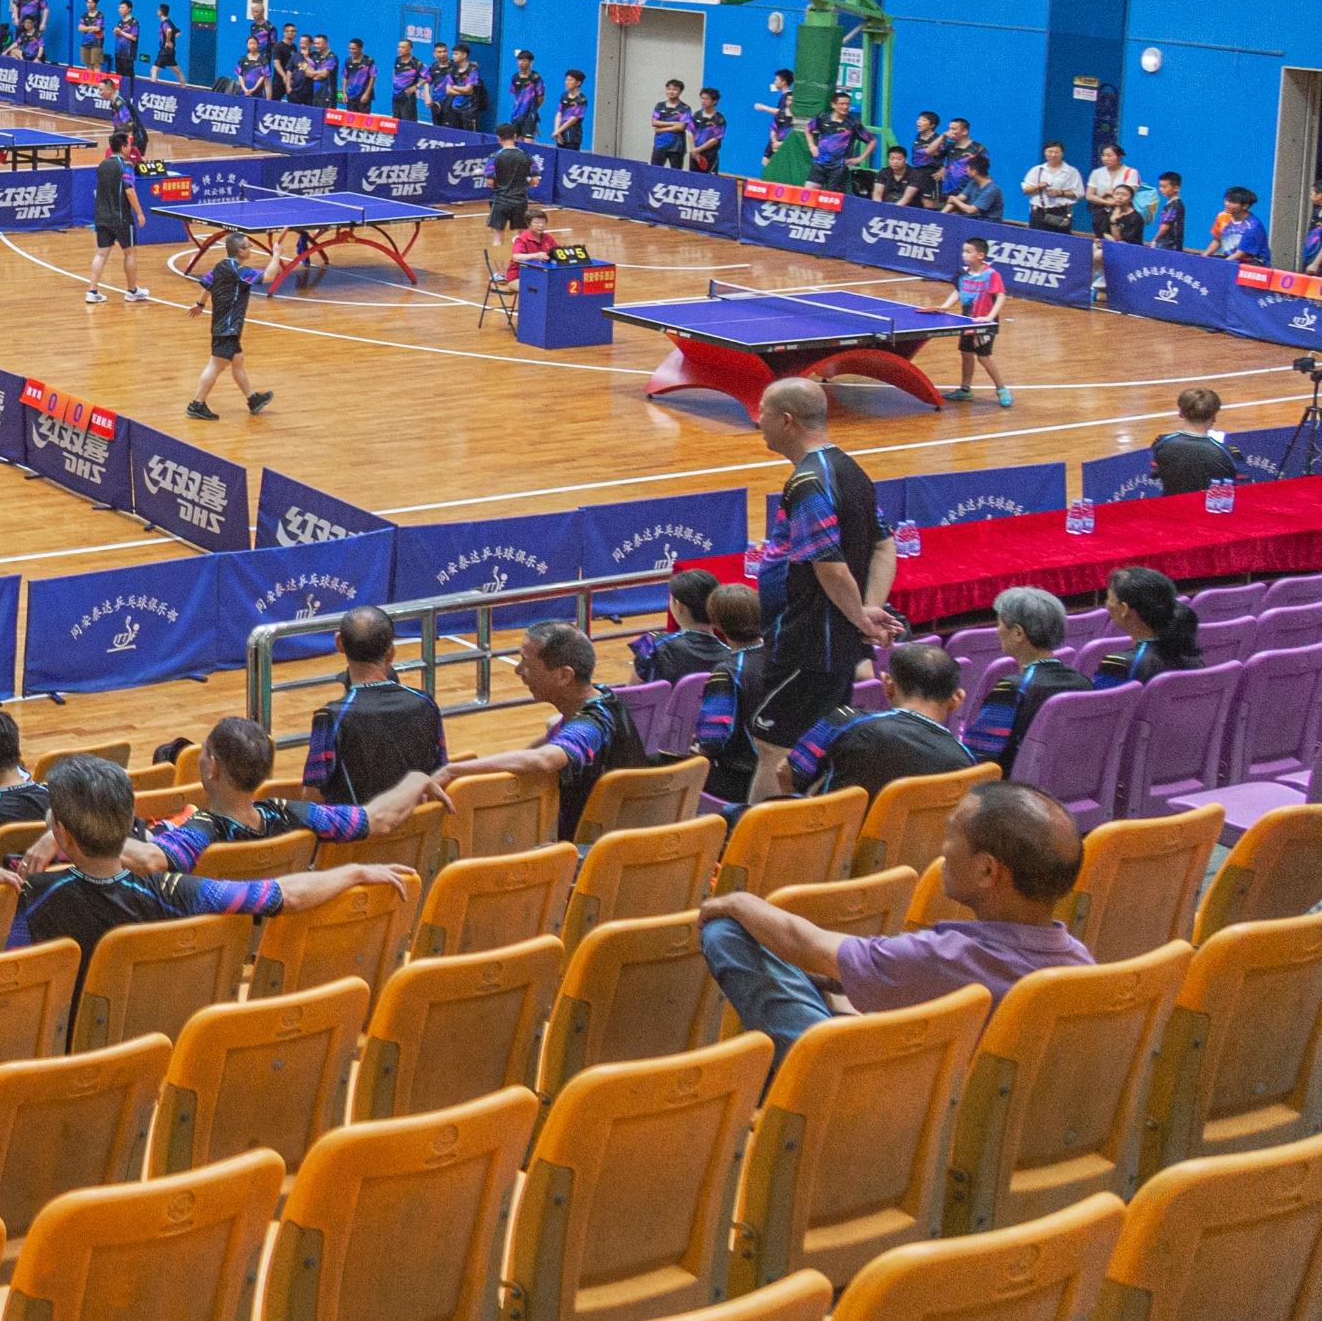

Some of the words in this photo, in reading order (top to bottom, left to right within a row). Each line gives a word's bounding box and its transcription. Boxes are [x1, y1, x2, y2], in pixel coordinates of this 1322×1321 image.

[139, 164, 147, 174] 0
[156, 162, 165, 172] 2
[362, 161, 430, 191] 红双喜
[563, 164, 632, 191] 红双喜
[154, 184, 160, 195] 3
[648, 183, 720, 211] 红双喜
[678, 205, 718, 224] DHS
[789, 224, 829, 244] DHS
[862, 216, 943, 246] 红双喜
[555, 248, 565, 259] 8
[577, 246, 586, 258] 5
[897, 242, 941, 262] DHS
[569, 281, 577, 293] 2
[1014, 268, 1067, 288] DHS
[63, 451, 106, 485] DHS
[143, 454, 228, 512] 红双喜
[176, 498, 225, 535] DHS
[611, 524, 713, 565] 同安泰达乒乓球俱乐部
[255, 573, 357, 613] 同安泰达乒乓球俱乐部
[70, 594, 179, 639] 同安泰达乒乓球俱乐部
